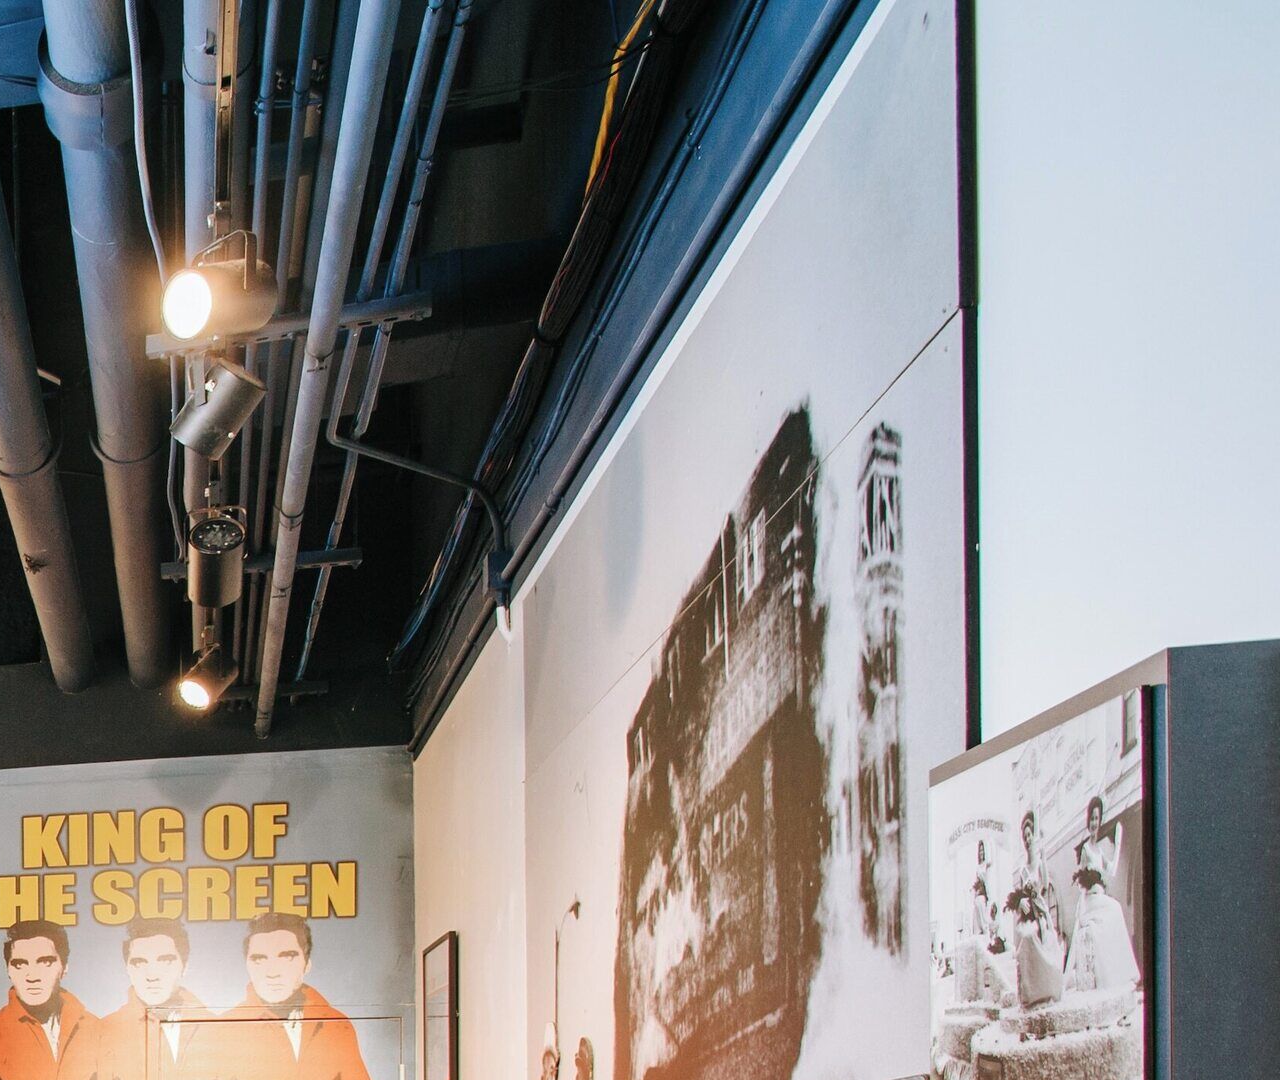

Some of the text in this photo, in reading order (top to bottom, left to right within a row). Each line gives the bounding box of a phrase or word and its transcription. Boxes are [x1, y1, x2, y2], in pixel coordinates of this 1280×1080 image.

[21, 801, 290, 870] KING OF
[91, 860, 358, 926] SCREEN
